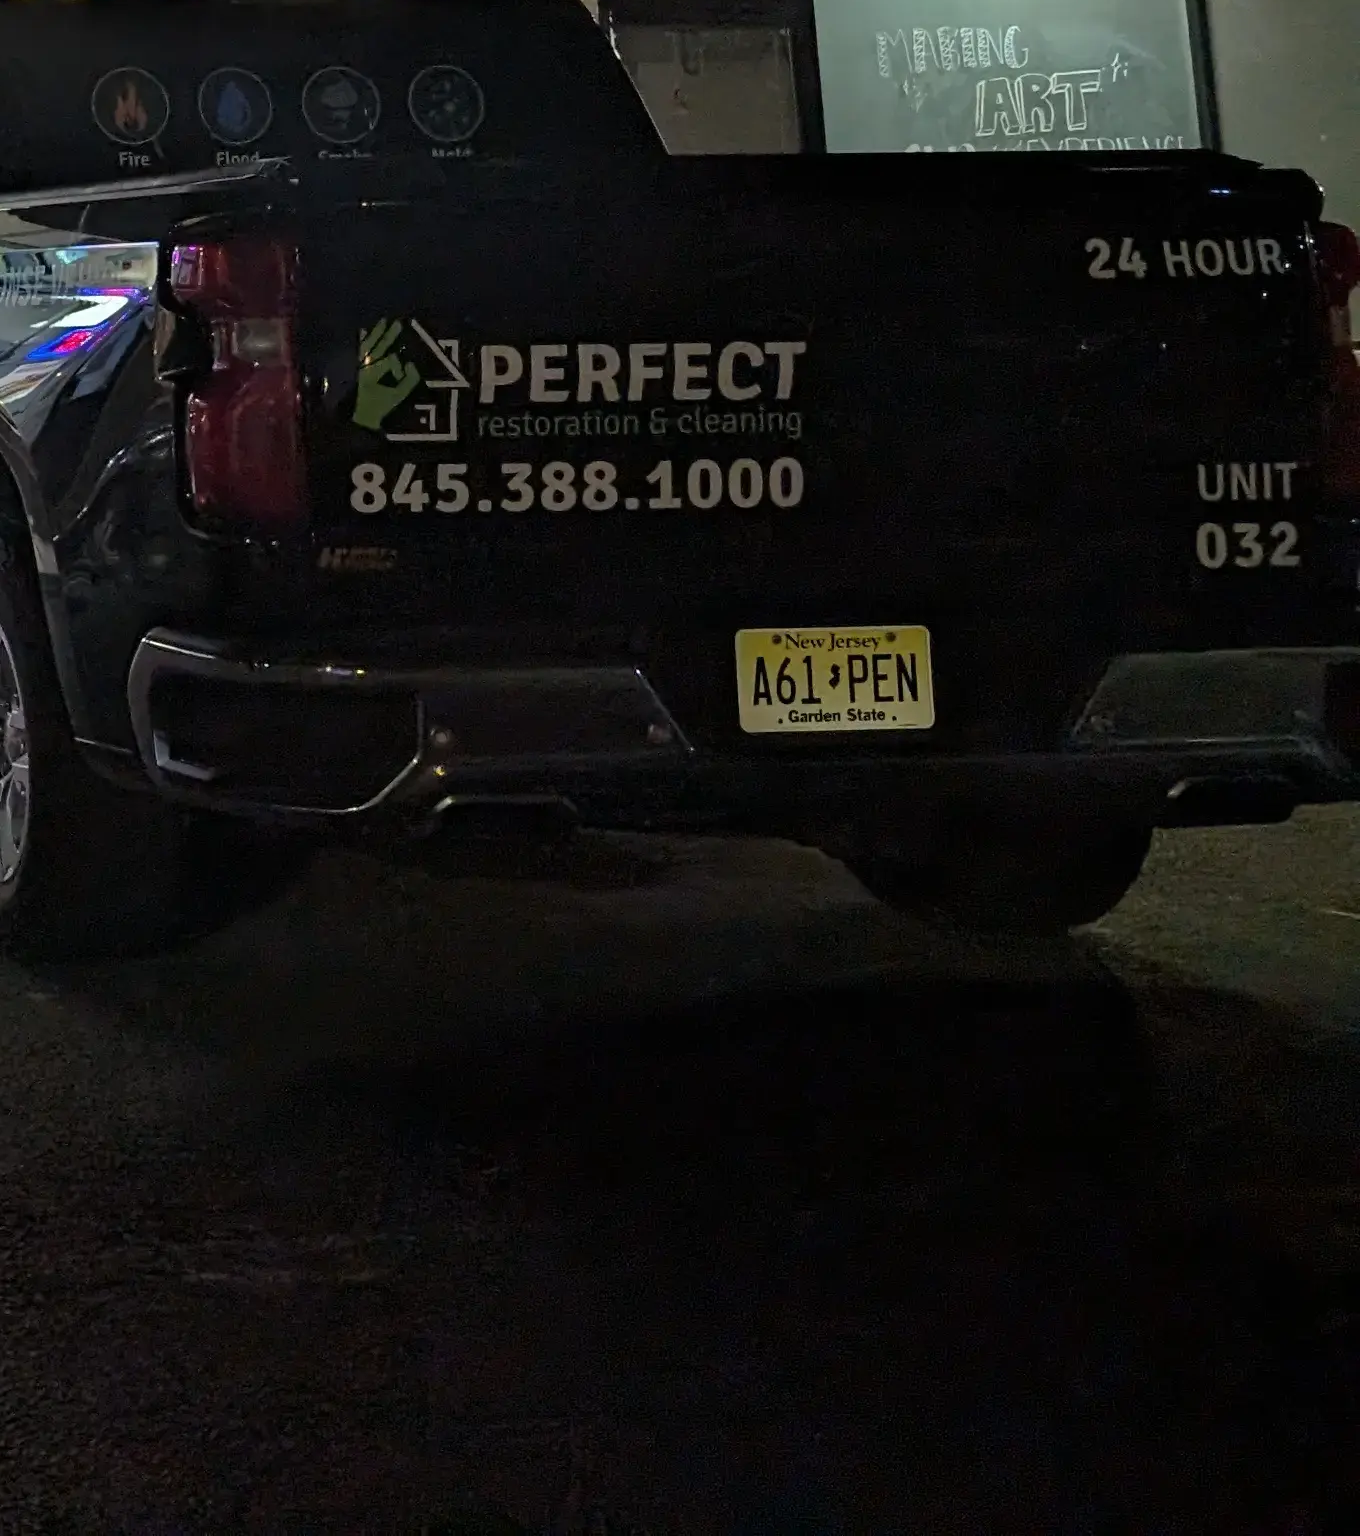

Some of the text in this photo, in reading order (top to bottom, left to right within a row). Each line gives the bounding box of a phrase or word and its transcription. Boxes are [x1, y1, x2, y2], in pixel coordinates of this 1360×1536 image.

[876, 25, 1030, 78] MAKING
[975, 68, 1104, 137] ART
[118, 152, 150, 166] Fire
[1084, 237, 1286, 280] 24 HOUR
[479, 341, 807, 404] PERFECT
[479, 404, 804, 440] restoration & cleaning
[349, 457, 805, 513] 845.388.1000
[1196, 461, 1298, 502] UNIT
[1195, 520, 1302, 570] 032
[785, 632, 881, 652] New Jersey
[753, 652, 919, 706] A61 PEN
[788, 707, 885, 723] Garden State
